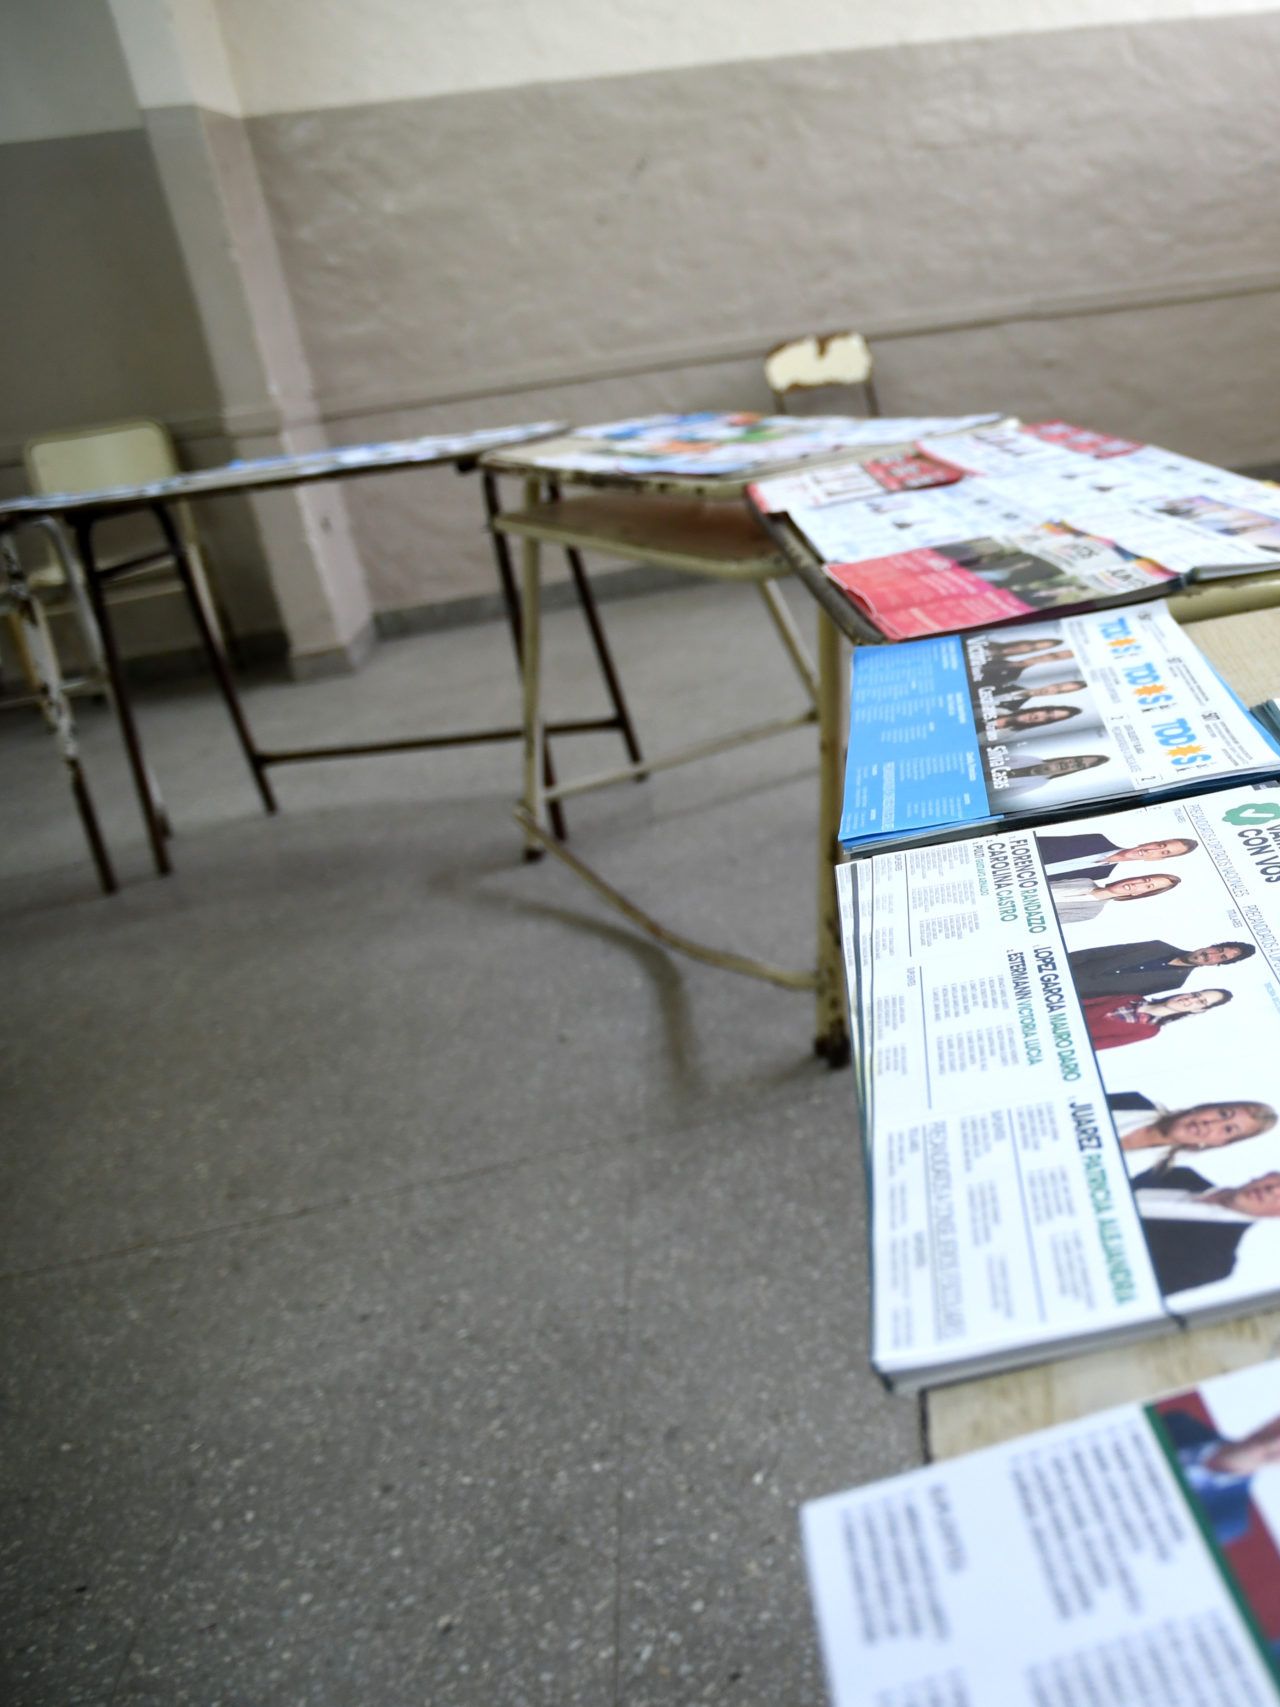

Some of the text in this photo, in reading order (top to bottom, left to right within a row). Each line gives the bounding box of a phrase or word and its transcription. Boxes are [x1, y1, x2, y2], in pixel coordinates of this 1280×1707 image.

[986, 744, 1011, 791] Silvia Casas
[1235, 827, 1275, 856] CON
[986, 841, 1015, 890] CAROLINA
[1008, 838, 1039, 889] FLORENCIO
[995, 888, 1019, 923] CASTRO
[1020, 887, 1048, 934] RANDAZZO
[1007, 951, 1032, 1001] ESTERMANN
[1033, 945, 1057, 974] LOPEZ
[1038, 972, 1067, 1013] GARCIA
[1017, 999, 1037, 1038] VICTORIA
[1048, 1012, 1074, 1050] MAURO
[1023, 1038, 1044, 1066] LUCIA
[1056, 1048, 1082, 1083] DARIO
[1068, 1099, 1142, 1306] JUAREZ PATRICIA ALEJANDRA
